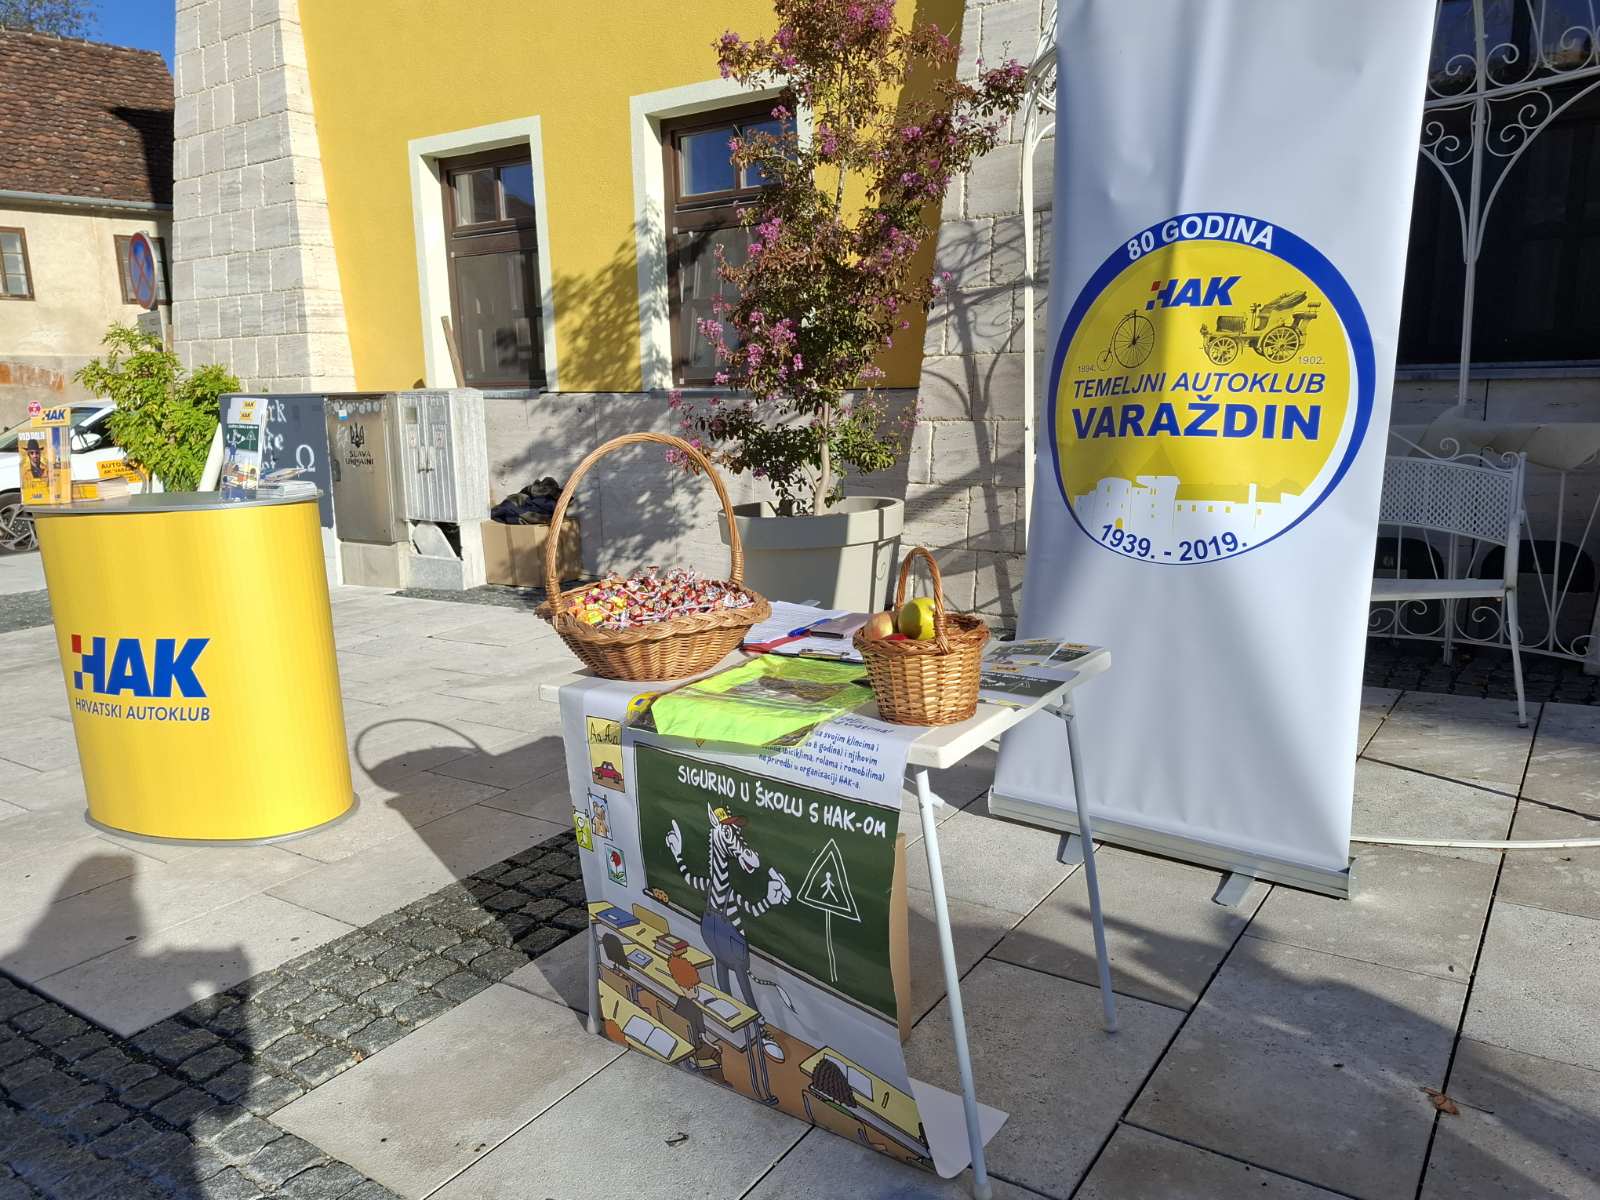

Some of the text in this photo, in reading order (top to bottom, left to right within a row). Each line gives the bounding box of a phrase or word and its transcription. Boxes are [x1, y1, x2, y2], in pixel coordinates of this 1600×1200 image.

[1126, 215, 1275, 261] 80 GODINA
[1145, 275, 1243, 311] HAK
[1074, 372, 1326, 400] TEMELJNI AUTOKLUB
[1071, 394, 1322, 441] VARAŽDIN
[1101, 524, 1155, 560] 1939.
[1178, 532, 1248, 562] 2019.
[71, 634, 211, 698] HAK
[75, 697, 211, 722] HRVATSKI AUTOKLUB
[824, 731, 846, 745] svojim
[815, 755, 839, 769] rolama
[677, 765, 887, 839] SIGURNO U ŠKOLU S HAK-OM
